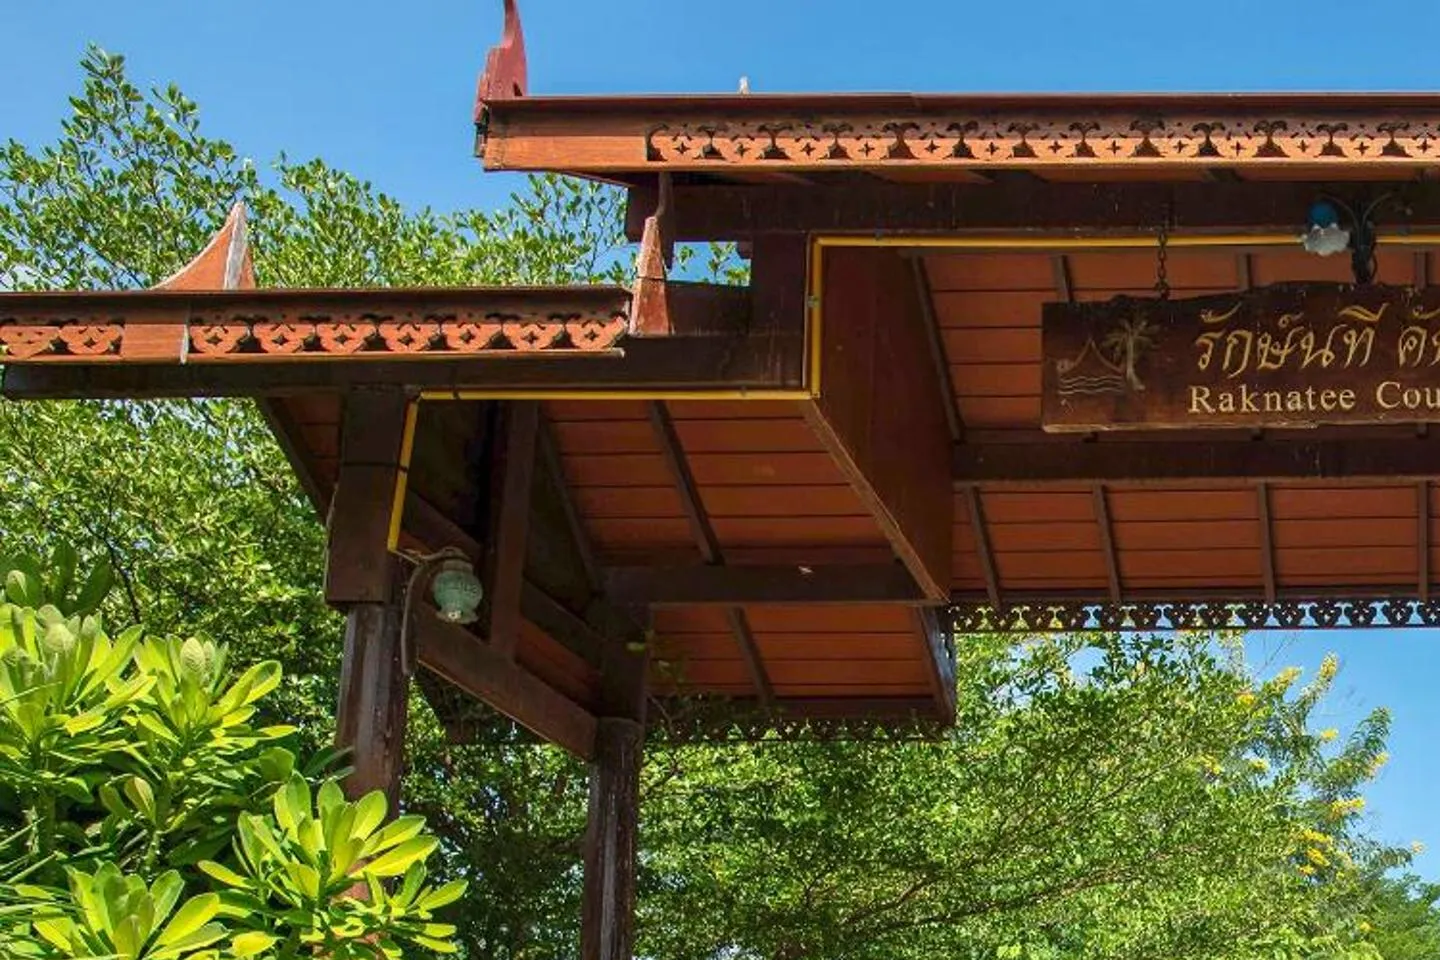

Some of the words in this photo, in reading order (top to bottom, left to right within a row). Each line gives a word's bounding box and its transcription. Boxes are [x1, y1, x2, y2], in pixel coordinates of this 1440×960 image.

[1195, 302, 1391, 379] รักษ์นที
[1188, 384, 1357, 415] Raknatee
